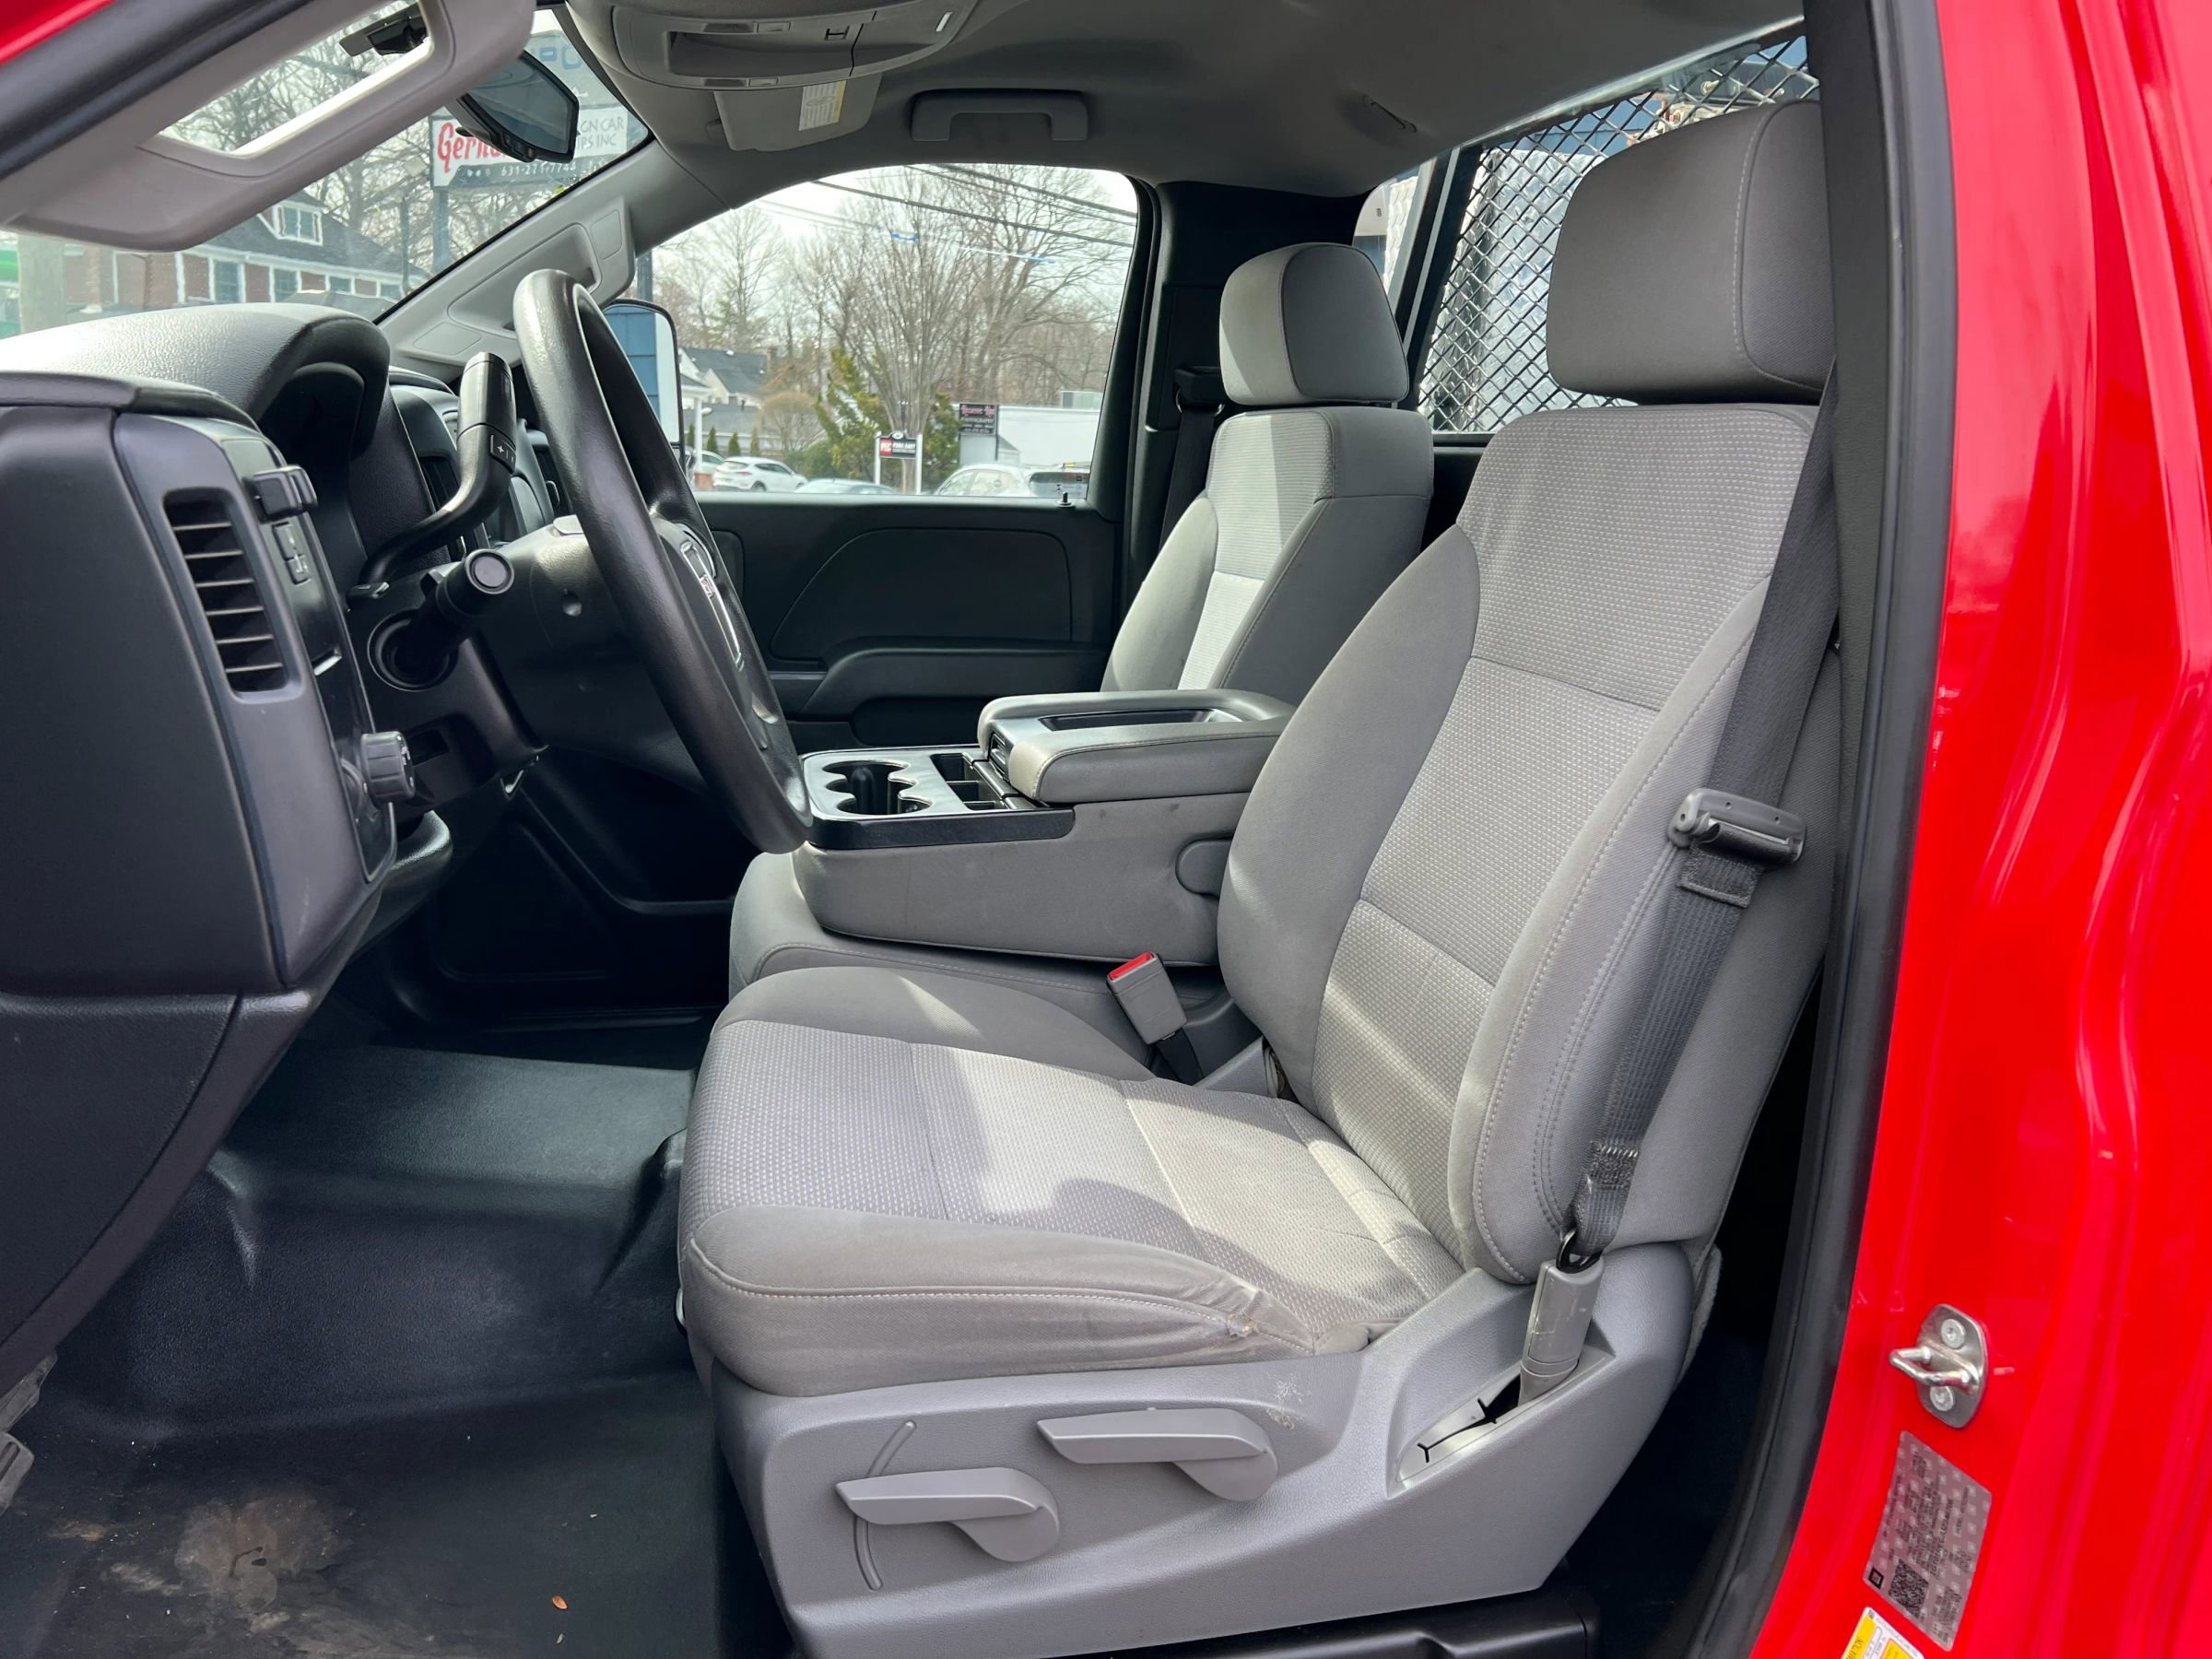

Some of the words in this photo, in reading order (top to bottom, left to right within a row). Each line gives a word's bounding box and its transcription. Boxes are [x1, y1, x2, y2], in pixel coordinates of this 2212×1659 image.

[580, 118, 598, 133] GN
[600, 116, 625, 132] CAR
[595, 132, 618, 148] INC
